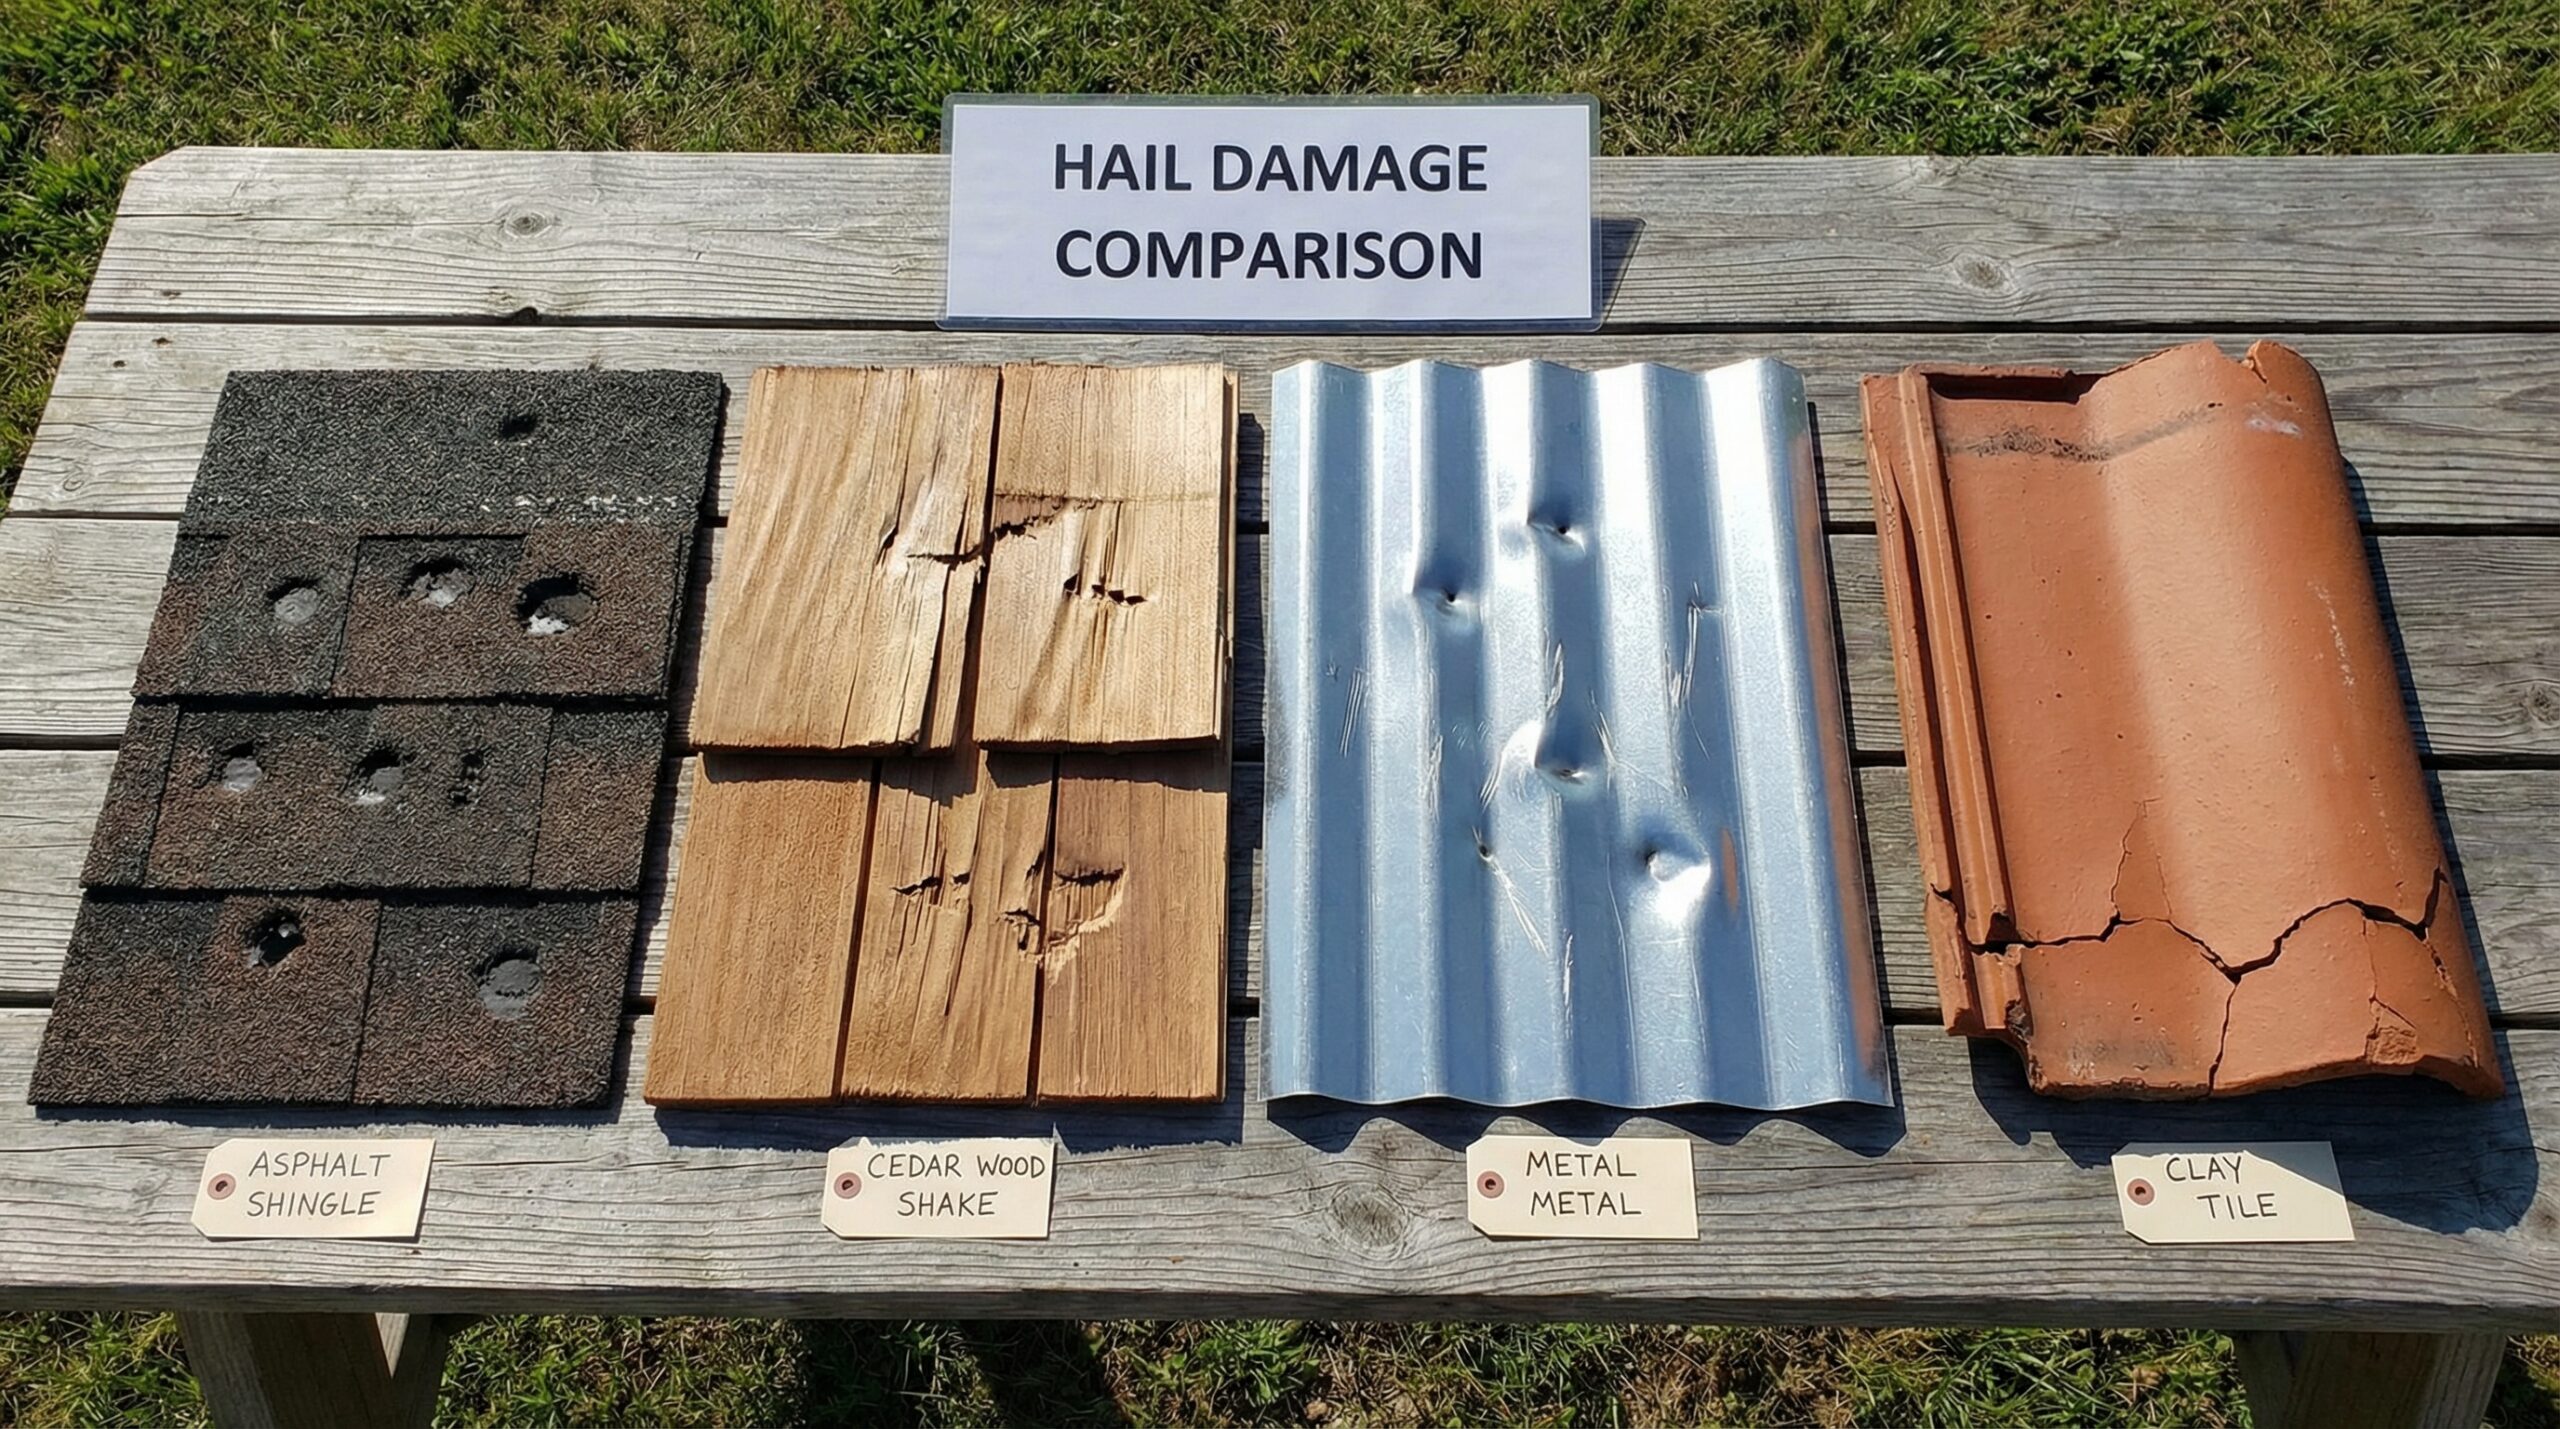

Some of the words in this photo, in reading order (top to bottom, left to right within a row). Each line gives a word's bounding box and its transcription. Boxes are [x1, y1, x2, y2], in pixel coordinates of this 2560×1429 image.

[1055, 143, 1192, 191] HAIL
[1213, 144, 1488, 192] DAMAGE
[1056, 229, 1481, 279] COMPARISON
[248, 1151, 391, 1177] ASPHALT
[867, 1153, 962, 1179] CEDAR
[976, 1154, 1045, 1179] WOOD
[1526, 1151, 1637, 1177] METAL
[2166, 1156, 2242, 1184] CLAY
[247, 1191, 381, 1217] SHINGLE
[897, 1191, 998, 1217] SHAKE
[1531, 1191, 1642, 1216] METAL
[2197, 1193, 2278, 1220] TILE
